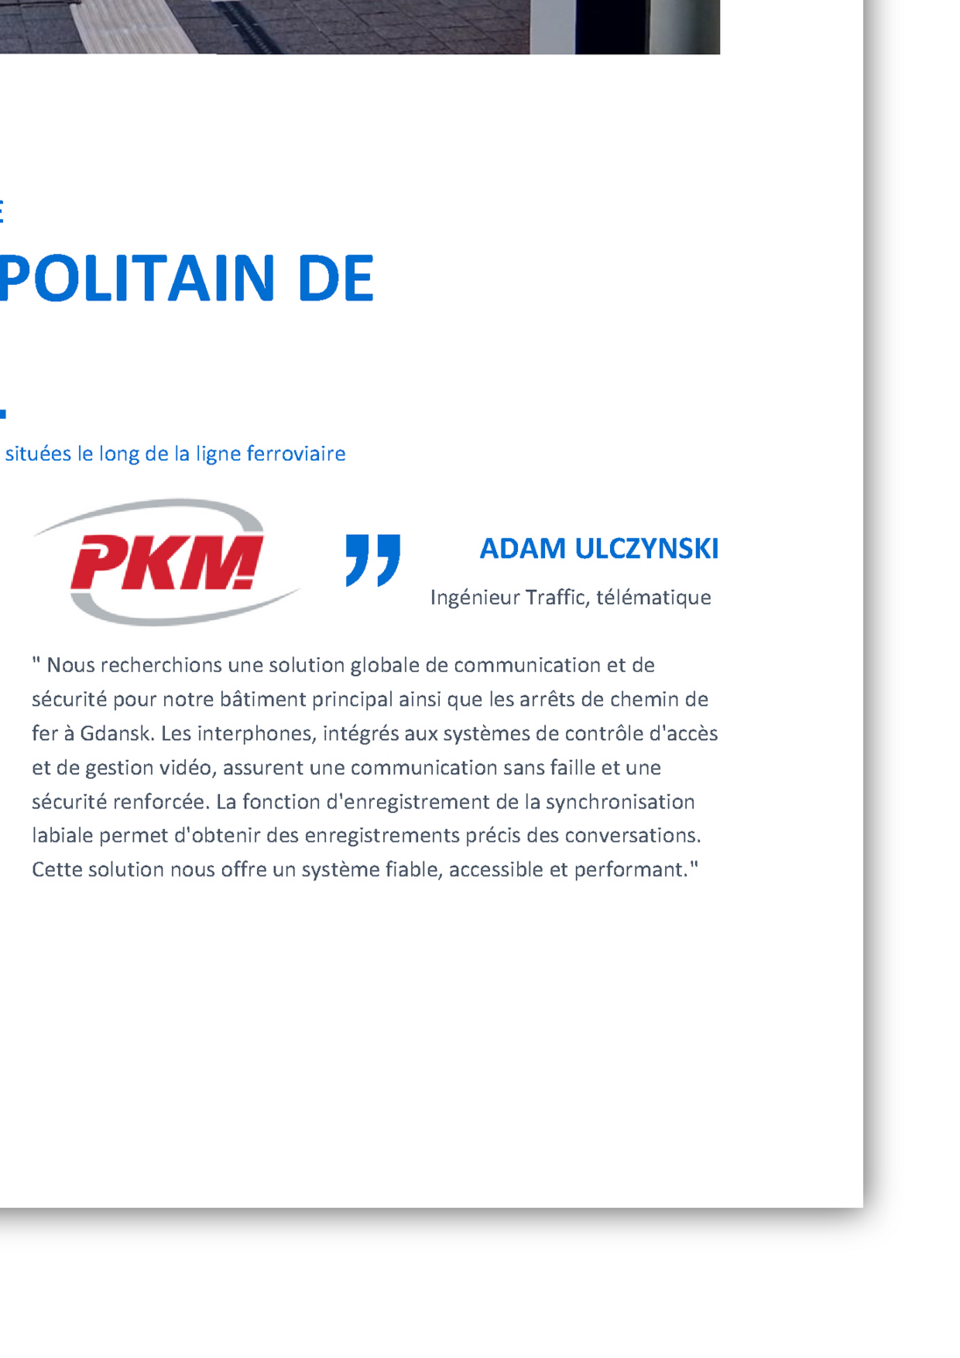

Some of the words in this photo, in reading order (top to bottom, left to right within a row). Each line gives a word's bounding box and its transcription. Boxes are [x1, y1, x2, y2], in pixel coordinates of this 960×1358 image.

[300, 255, 373, 301] DE
[6, 445, 71, 461] situées
[79, 445, 92, 461] le
[100, 445, 139, 465] long
[146, 445, 168, 461] de
[176, 445, 189, 461] la
[197, 445, 240, 465] ligne
[247, 444, 345, 461] ferroviaire
[480, 538, 565, 558] ADAM
[576, 537, 718, 559] ULCZYNSKI
[70, 533, 265, 591] PKM
[432, 588, 520, 609] Ingénieur
[526, 588, 589, 608] Traffic,
[597, 588, 711, 608] télématique
[32, 724, 58, 740] fer
[65, 725, 74, 740] à
[81, 725, 154, 740] Gdansk.
[163, 726, 191, 740] Les
[198, 725, 316, 745] interphones,
[324, 724, 399, 745] intégrés
[406, 729, 437, 740] aux
[444, 725, 530, 745] systèmes
[537, 725, 558, 740] de
[566, 724, 643, 740] contrôle
[32, 793, 106, 809] sécurité
[115, 793, 209, 809] renforcée.
[218, 794, 235, 809] La
[243, 793, 319, 809] fonction
[497, 793, 518, 809] de
[526, 794, 540, 809] la
[547, 793, 694, 813] synchronisation
[33, 862, 82, 877] Cette
[89, 861, 163, 876] solution
[172, 865, 215, 877] nous
[222, 860, 266, 877] offre
[274, 865, 295, 876] un
[302, 861, 379, 881] système
[386, 860, 442, 880] fiable,
[450, 861, 542, 877] accessible
[551, 863, 567, 876] et
[576, 860, 697, 881] performant."
